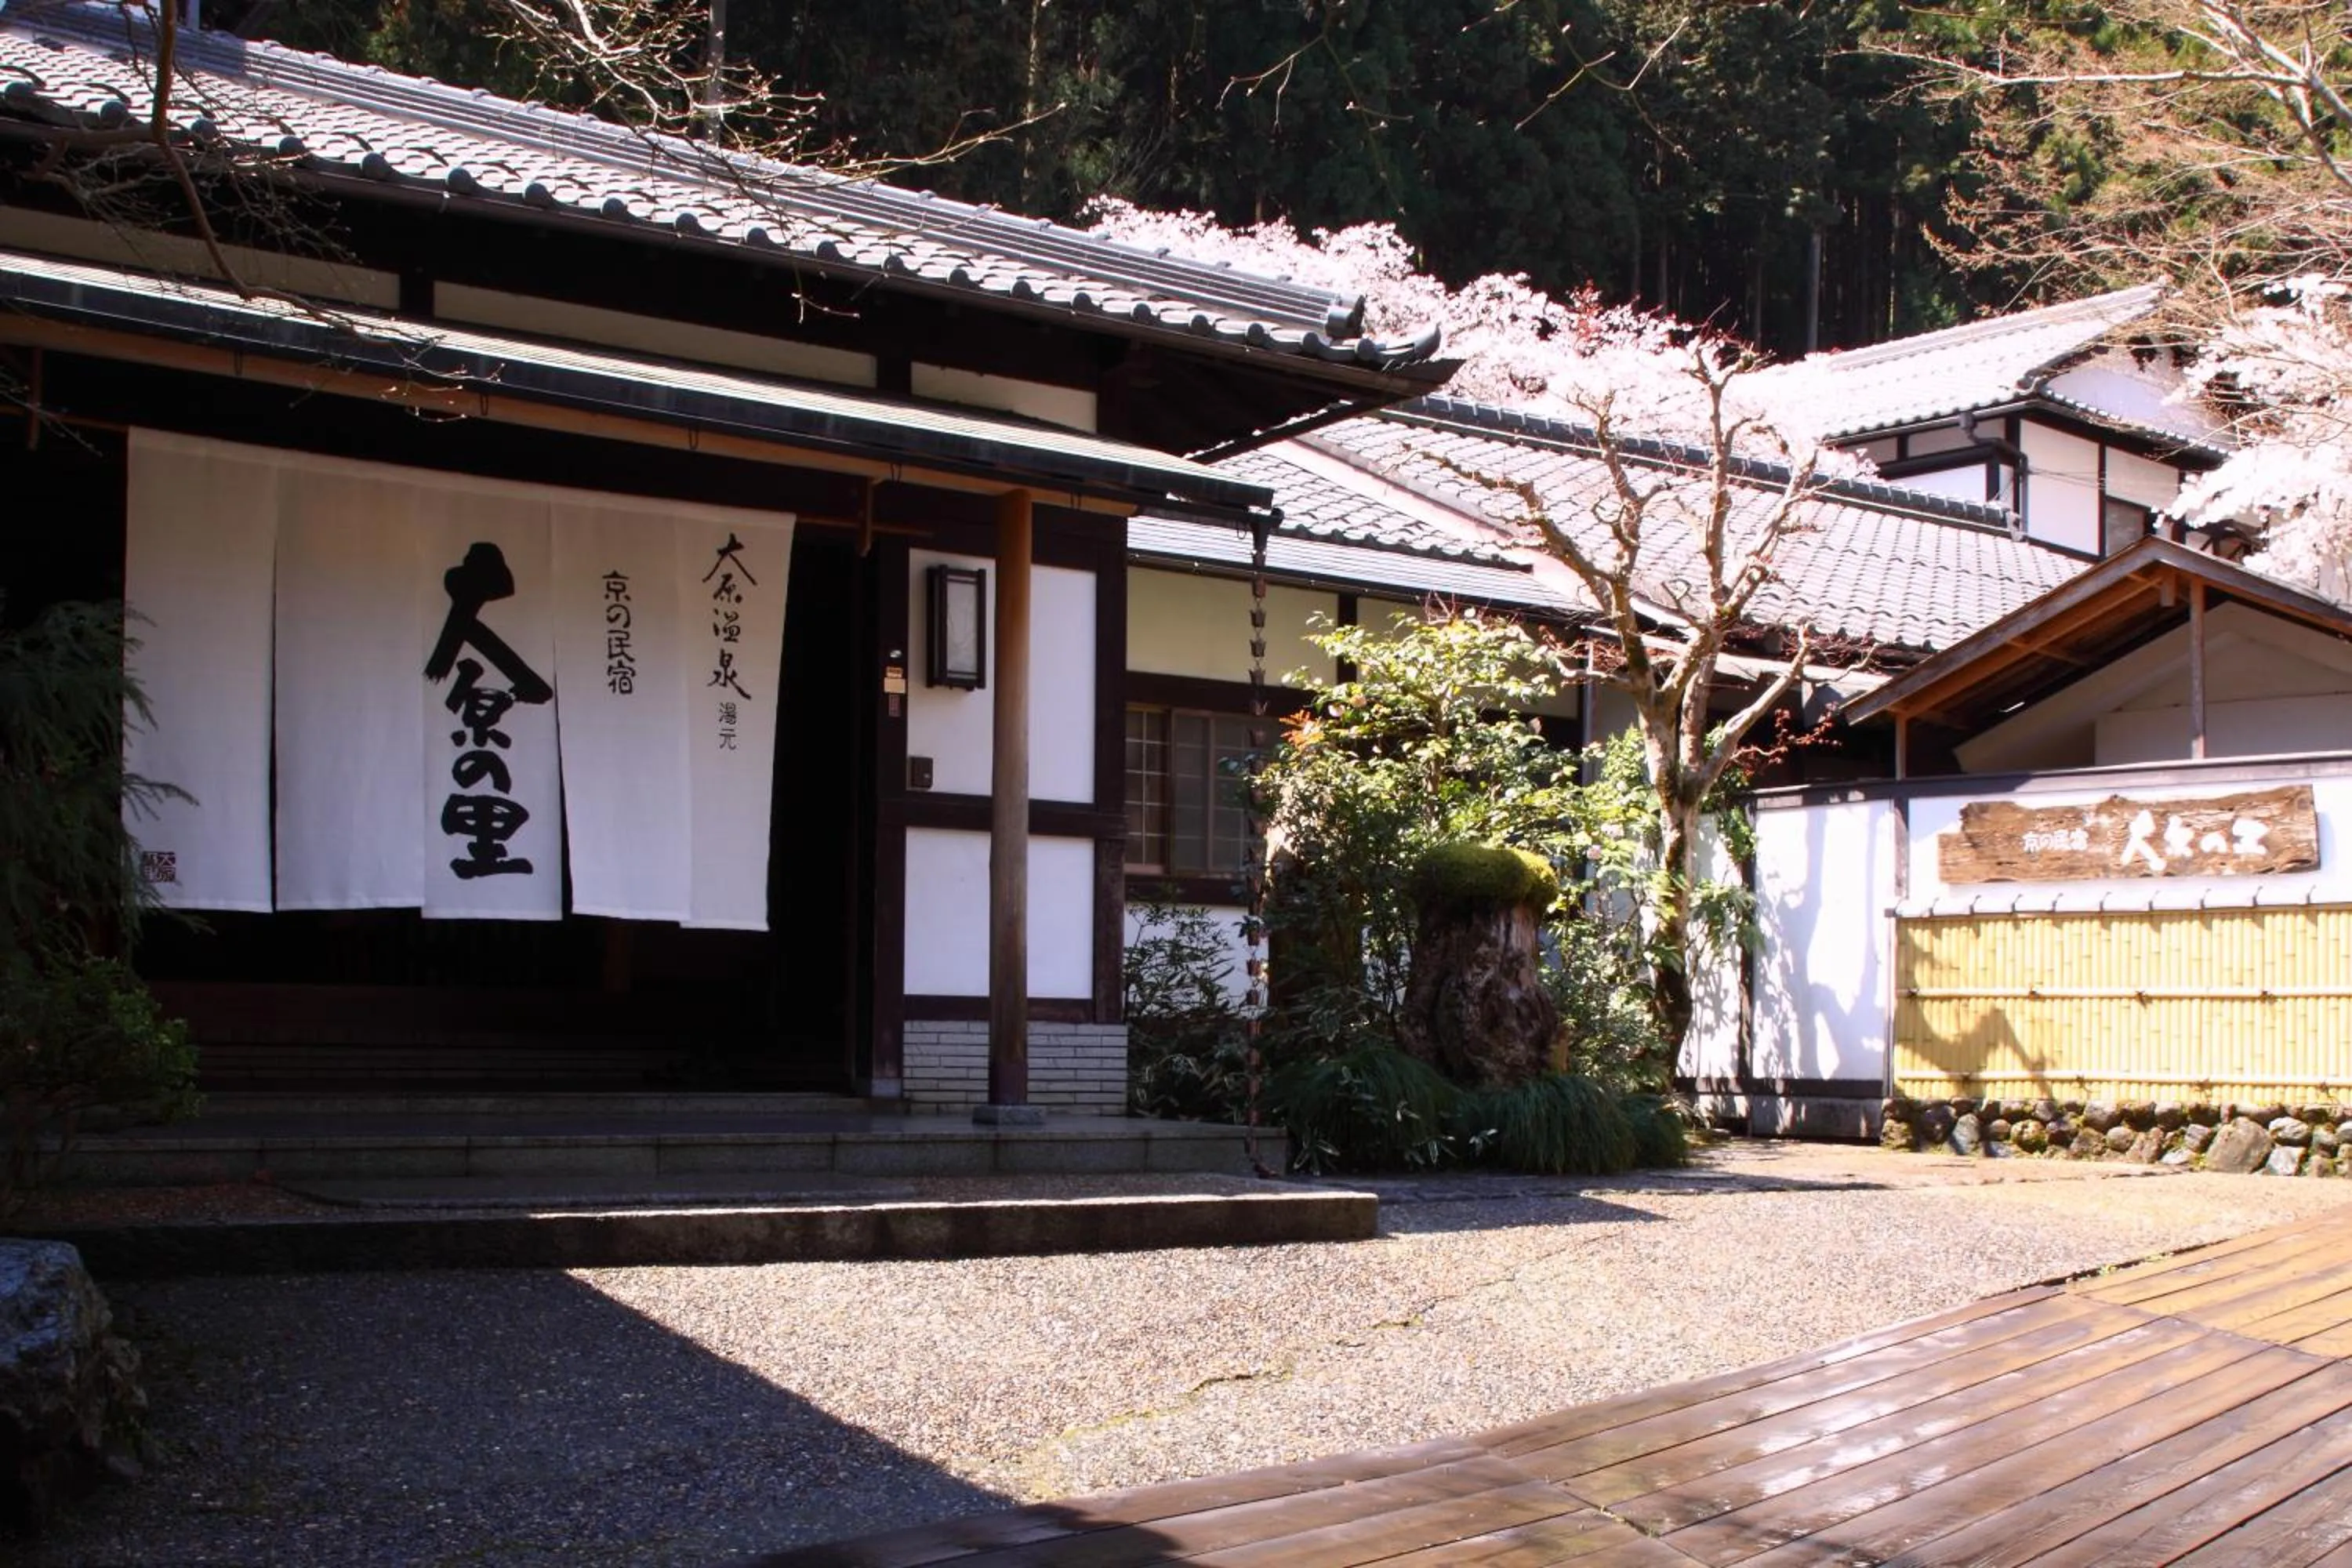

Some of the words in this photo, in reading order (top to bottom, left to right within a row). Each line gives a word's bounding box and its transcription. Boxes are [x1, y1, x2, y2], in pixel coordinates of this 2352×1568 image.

[601, 569, 637, 695] 京の民宿
[702, 532, 758, 700] 大原温泉
[423, 542, 554, 880] 大原の里
